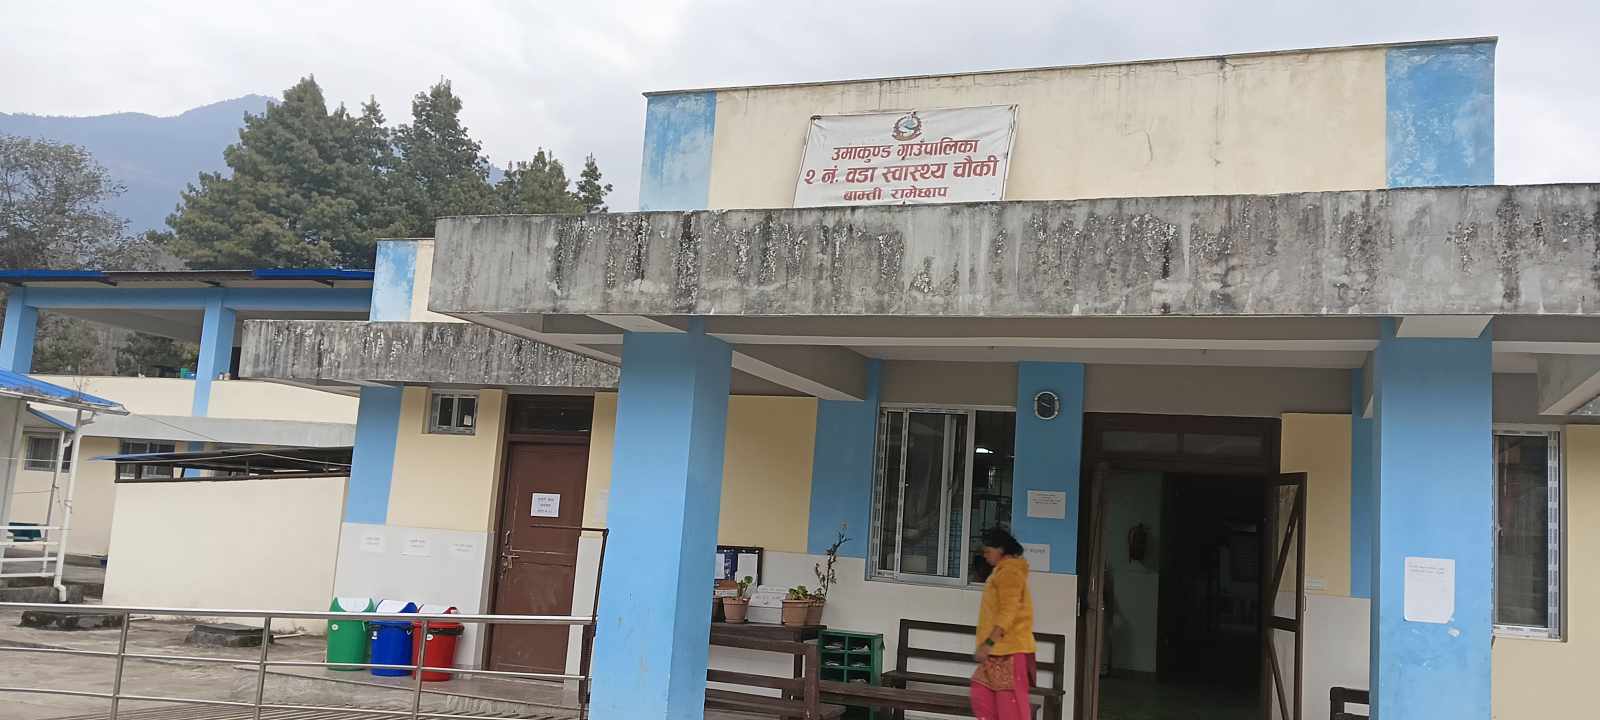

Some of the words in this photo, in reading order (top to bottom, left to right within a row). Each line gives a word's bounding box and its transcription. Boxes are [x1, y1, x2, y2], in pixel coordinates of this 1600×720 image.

[832, 145, 893, 163] उमाकुण्ड
[804, 169, 816, 185] २
[845, 166, 878, 183] वडा
[882, 162, 947, 182] स्वास्थ्य
[953, 155, 1000, 177] चौकी
[891, 185, 949, 200] रामेछाप
